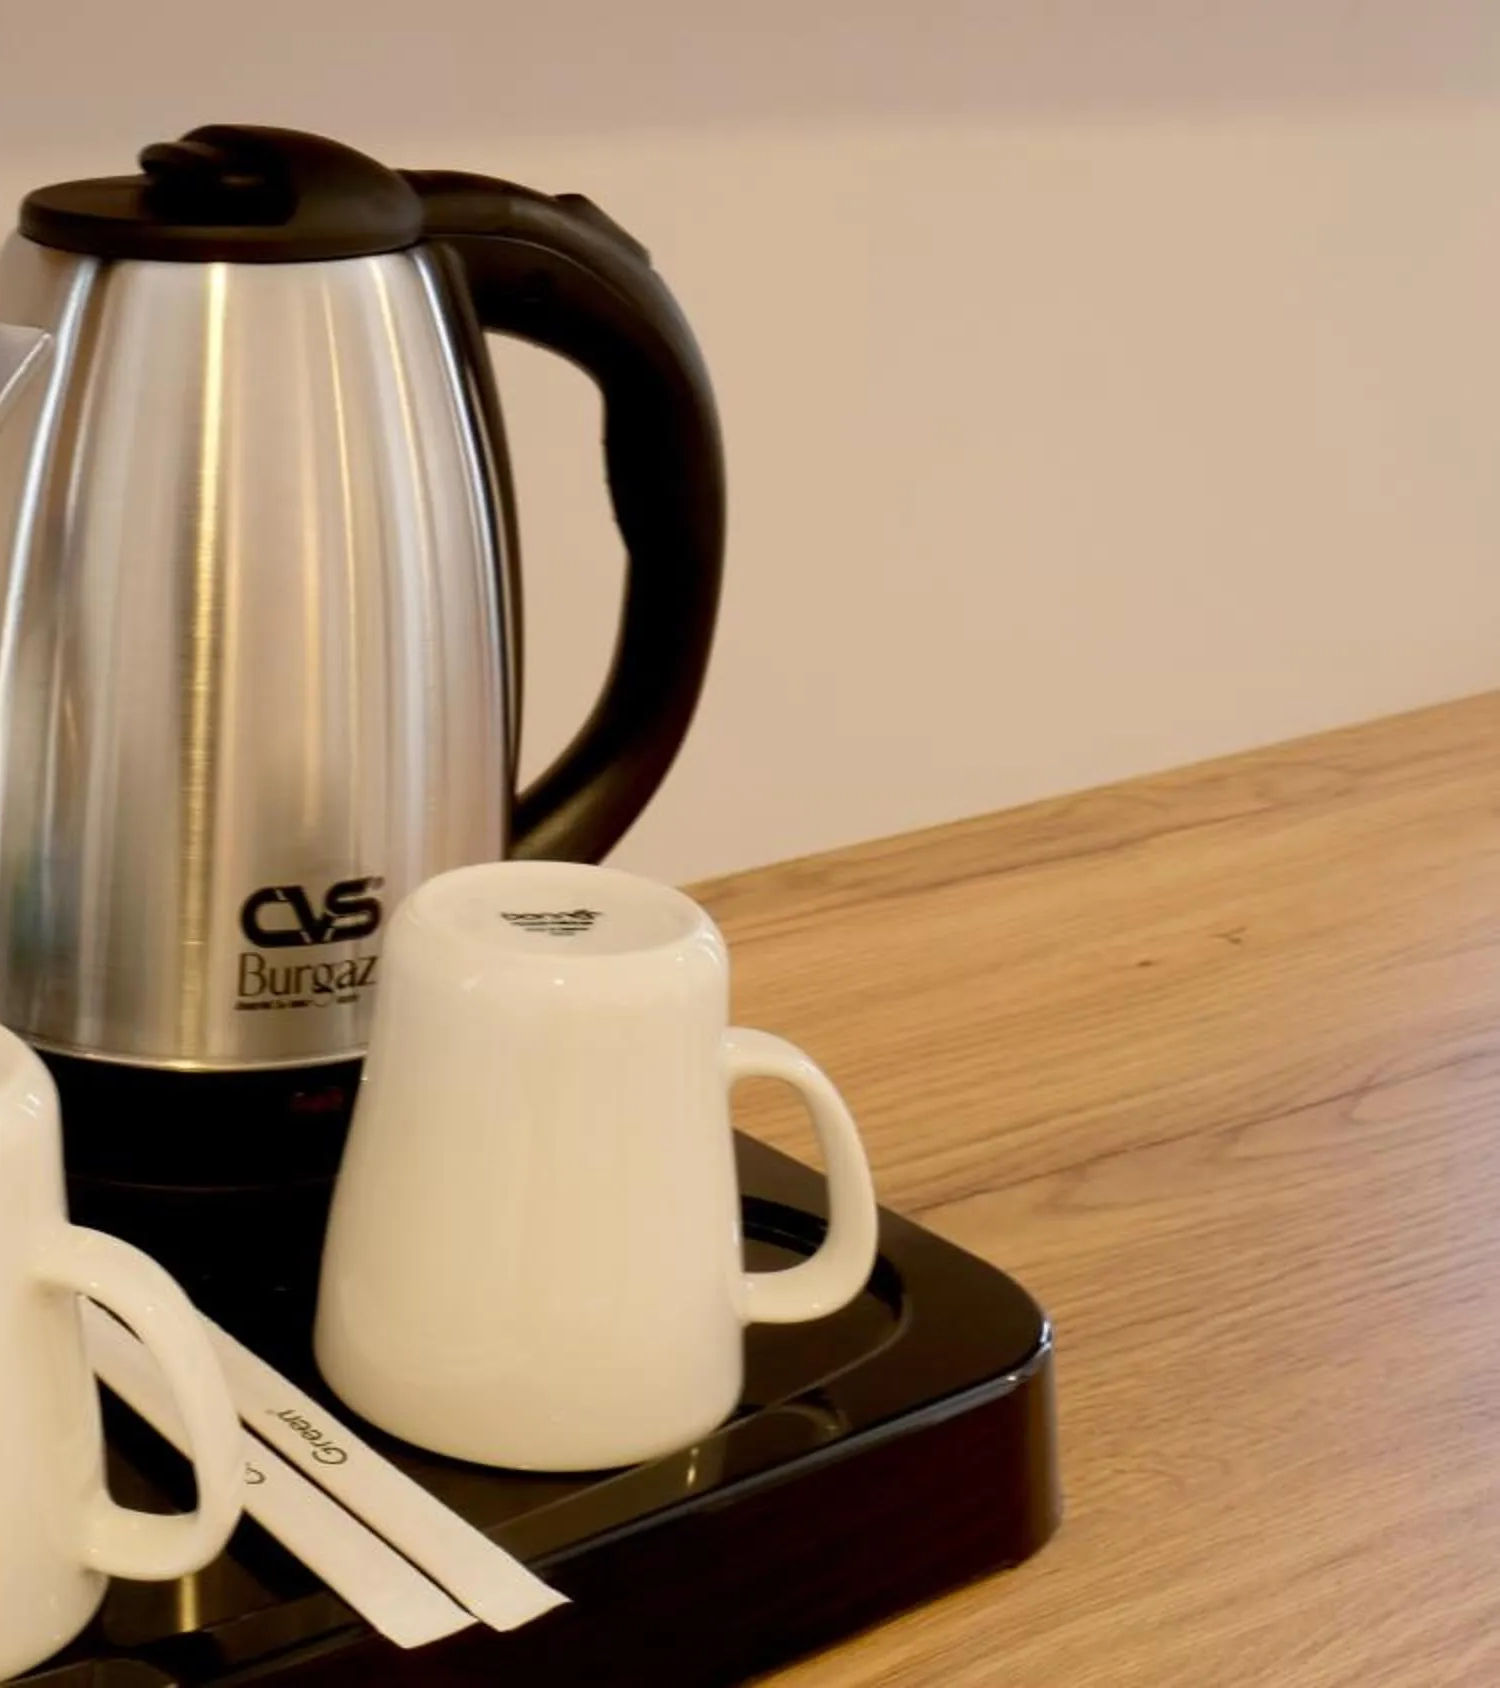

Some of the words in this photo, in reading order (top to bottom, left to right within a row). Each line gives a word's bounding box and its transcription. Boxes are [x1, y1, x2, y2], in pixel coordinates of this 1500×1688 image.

[241, 876, 382, 949] CVS
[237, 952, 378, 1007] Burgaz
[275, 1408, 348, 1465] Green
